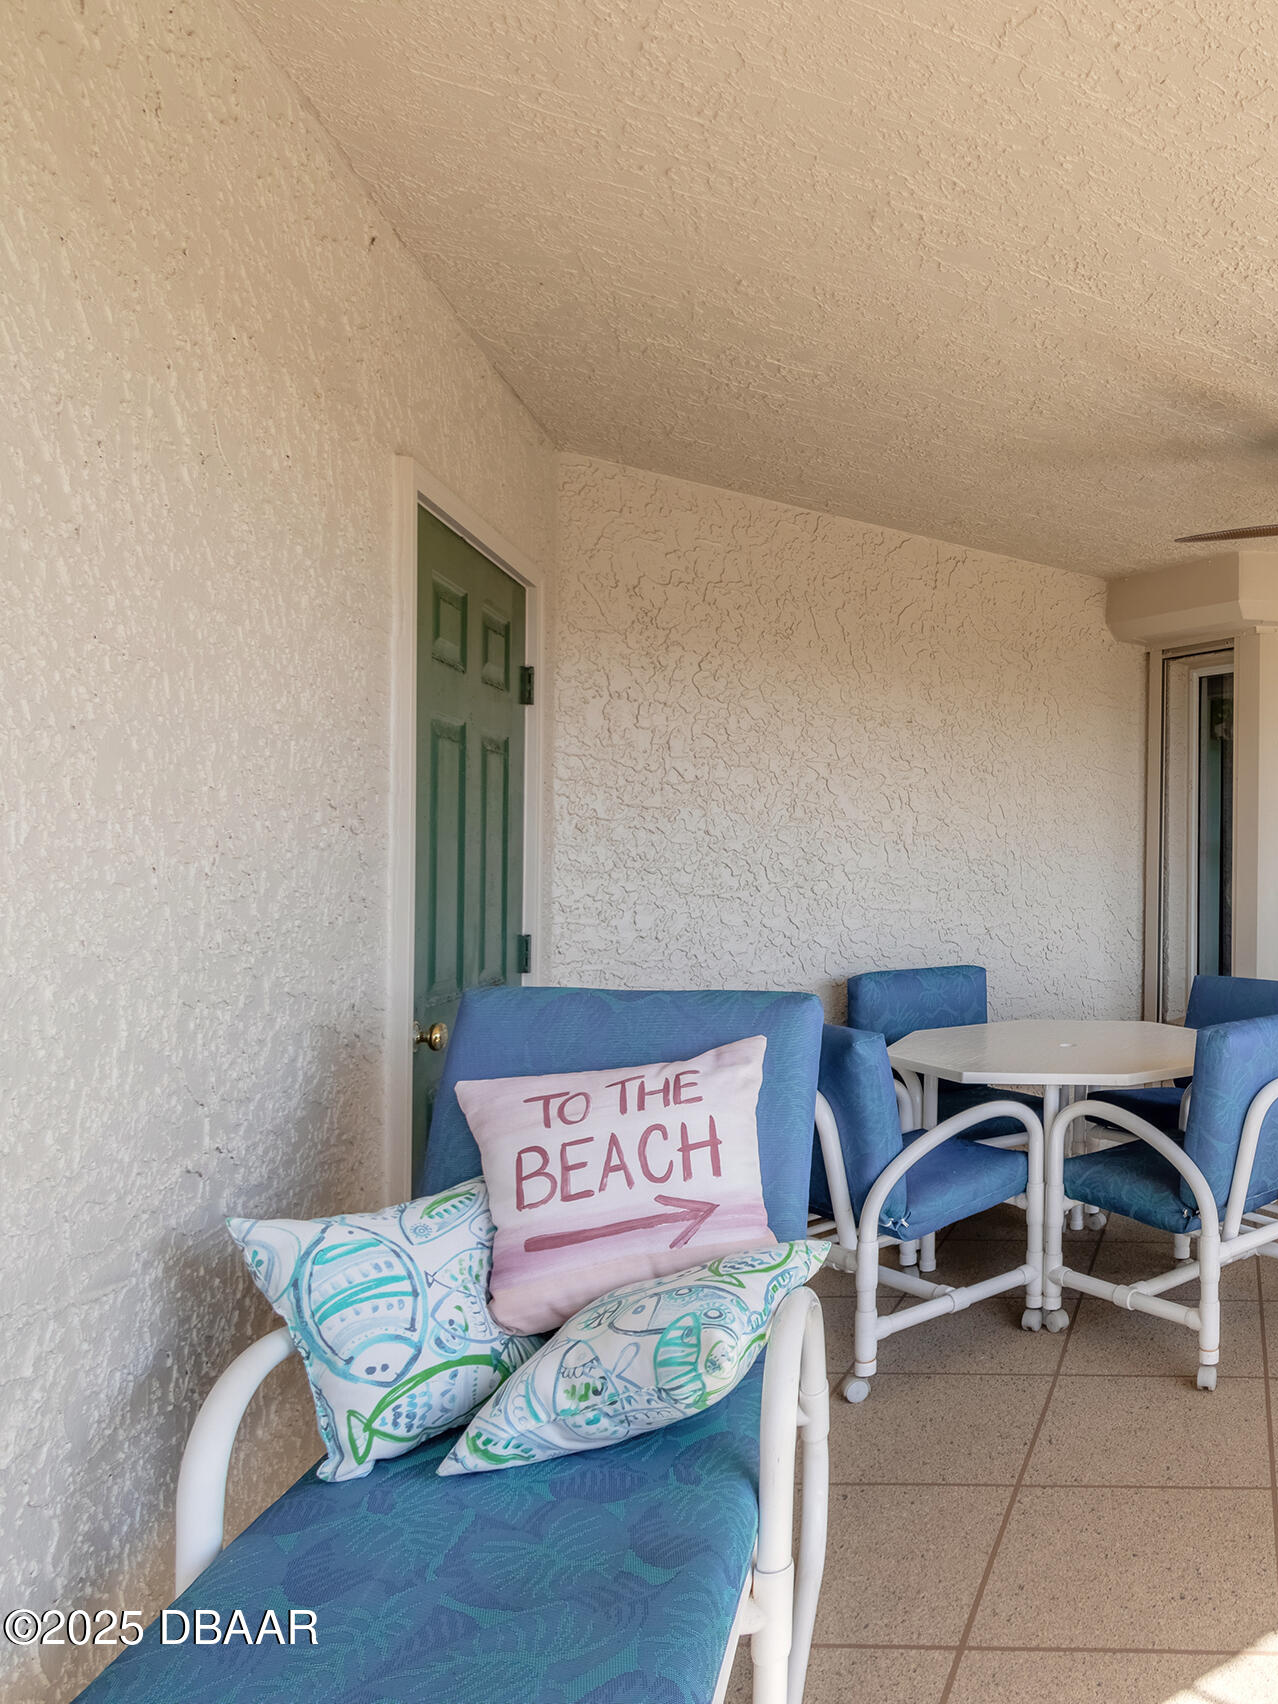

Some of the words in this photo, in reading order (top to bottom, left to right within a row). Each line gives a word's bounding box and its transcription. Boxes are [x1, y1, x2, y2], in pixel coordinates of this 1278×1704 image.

[523, 1091, 592, 1129] TO
[604, 1070, 704, 1115] THE
[515, 1114, 723, 1212] BEACH
